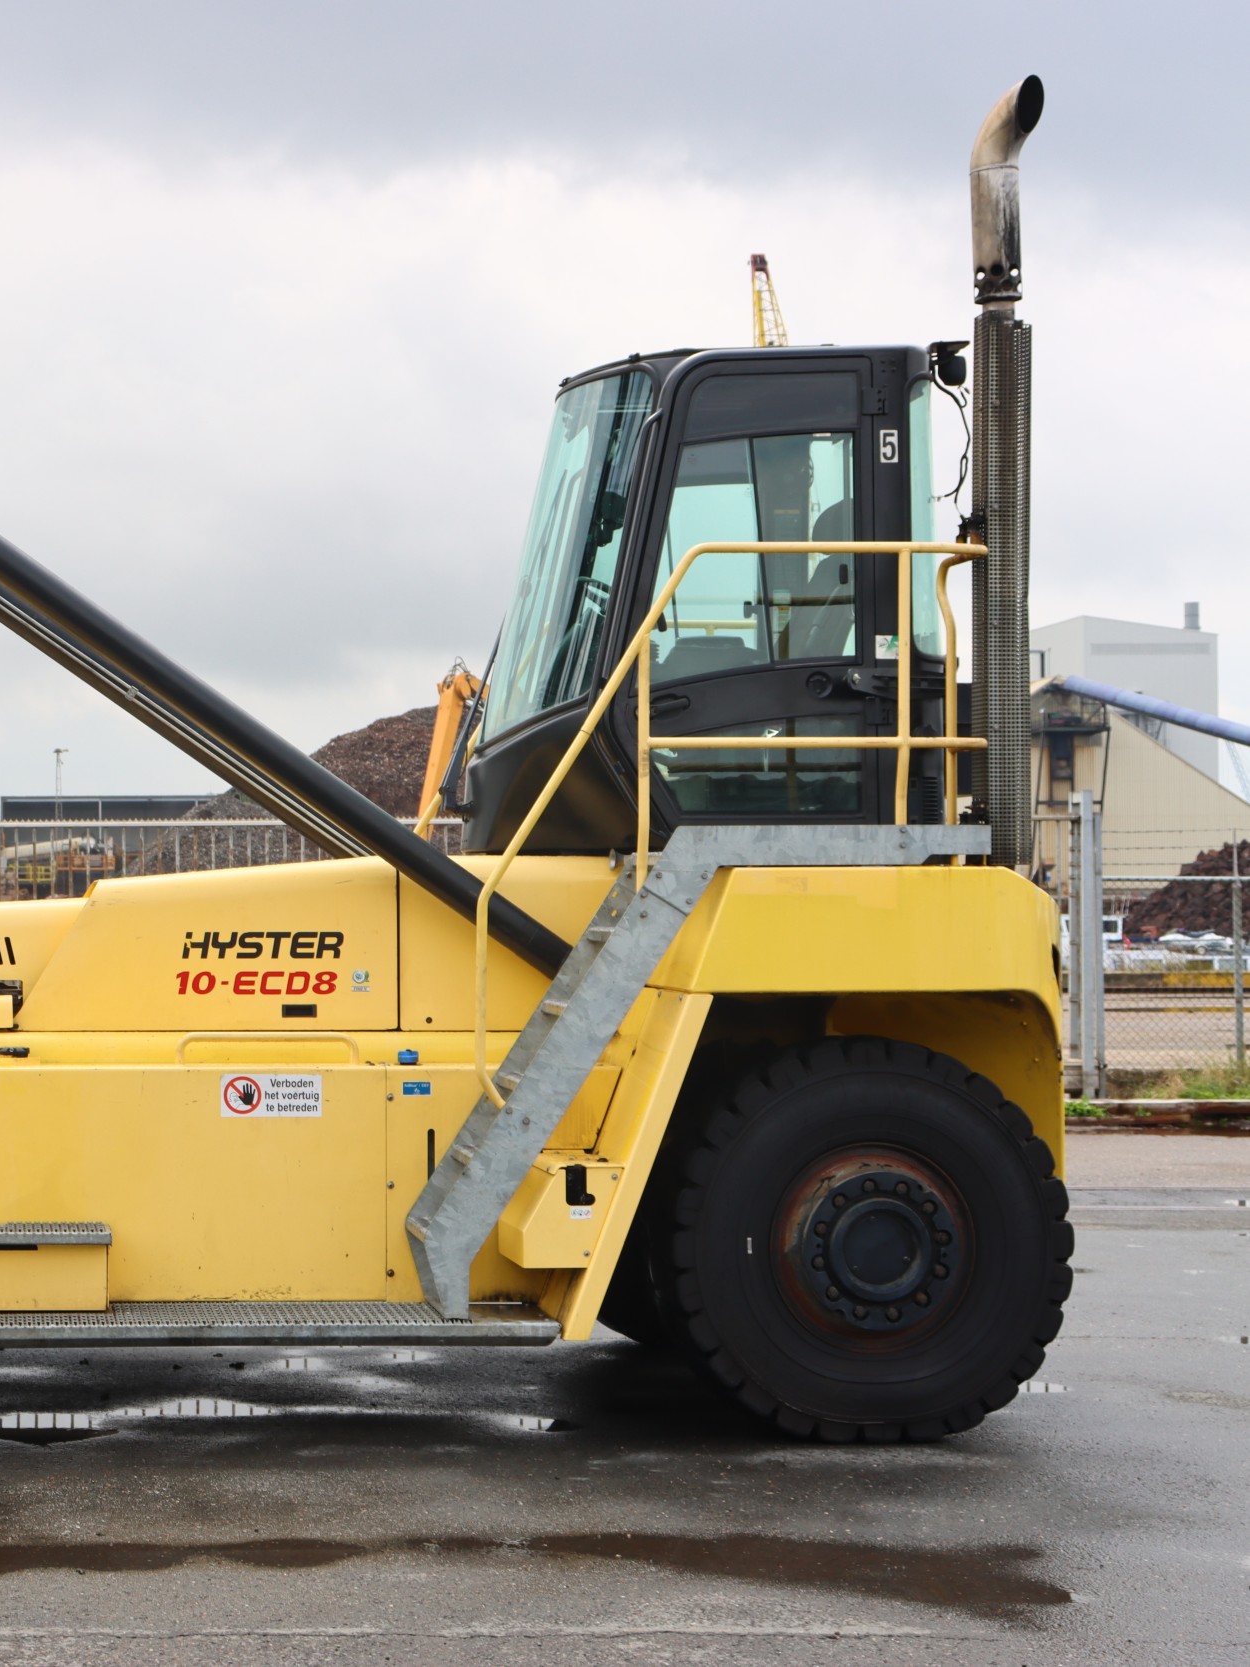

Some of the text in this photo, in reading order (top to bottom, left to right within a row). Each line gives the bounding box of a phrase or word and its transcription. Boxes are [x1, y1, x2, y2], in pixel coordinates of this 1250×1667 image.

[881, 432, 896, 461] 5
[181, 931, 345, 959] HYSTER
[175, 971, 338, 995] 10-ECD8
[269, 1078, 314, 1088] Verboden
[264, 1091, 320, 1102] het voertuig
[266, 1103, 318, 1112] te betreden
